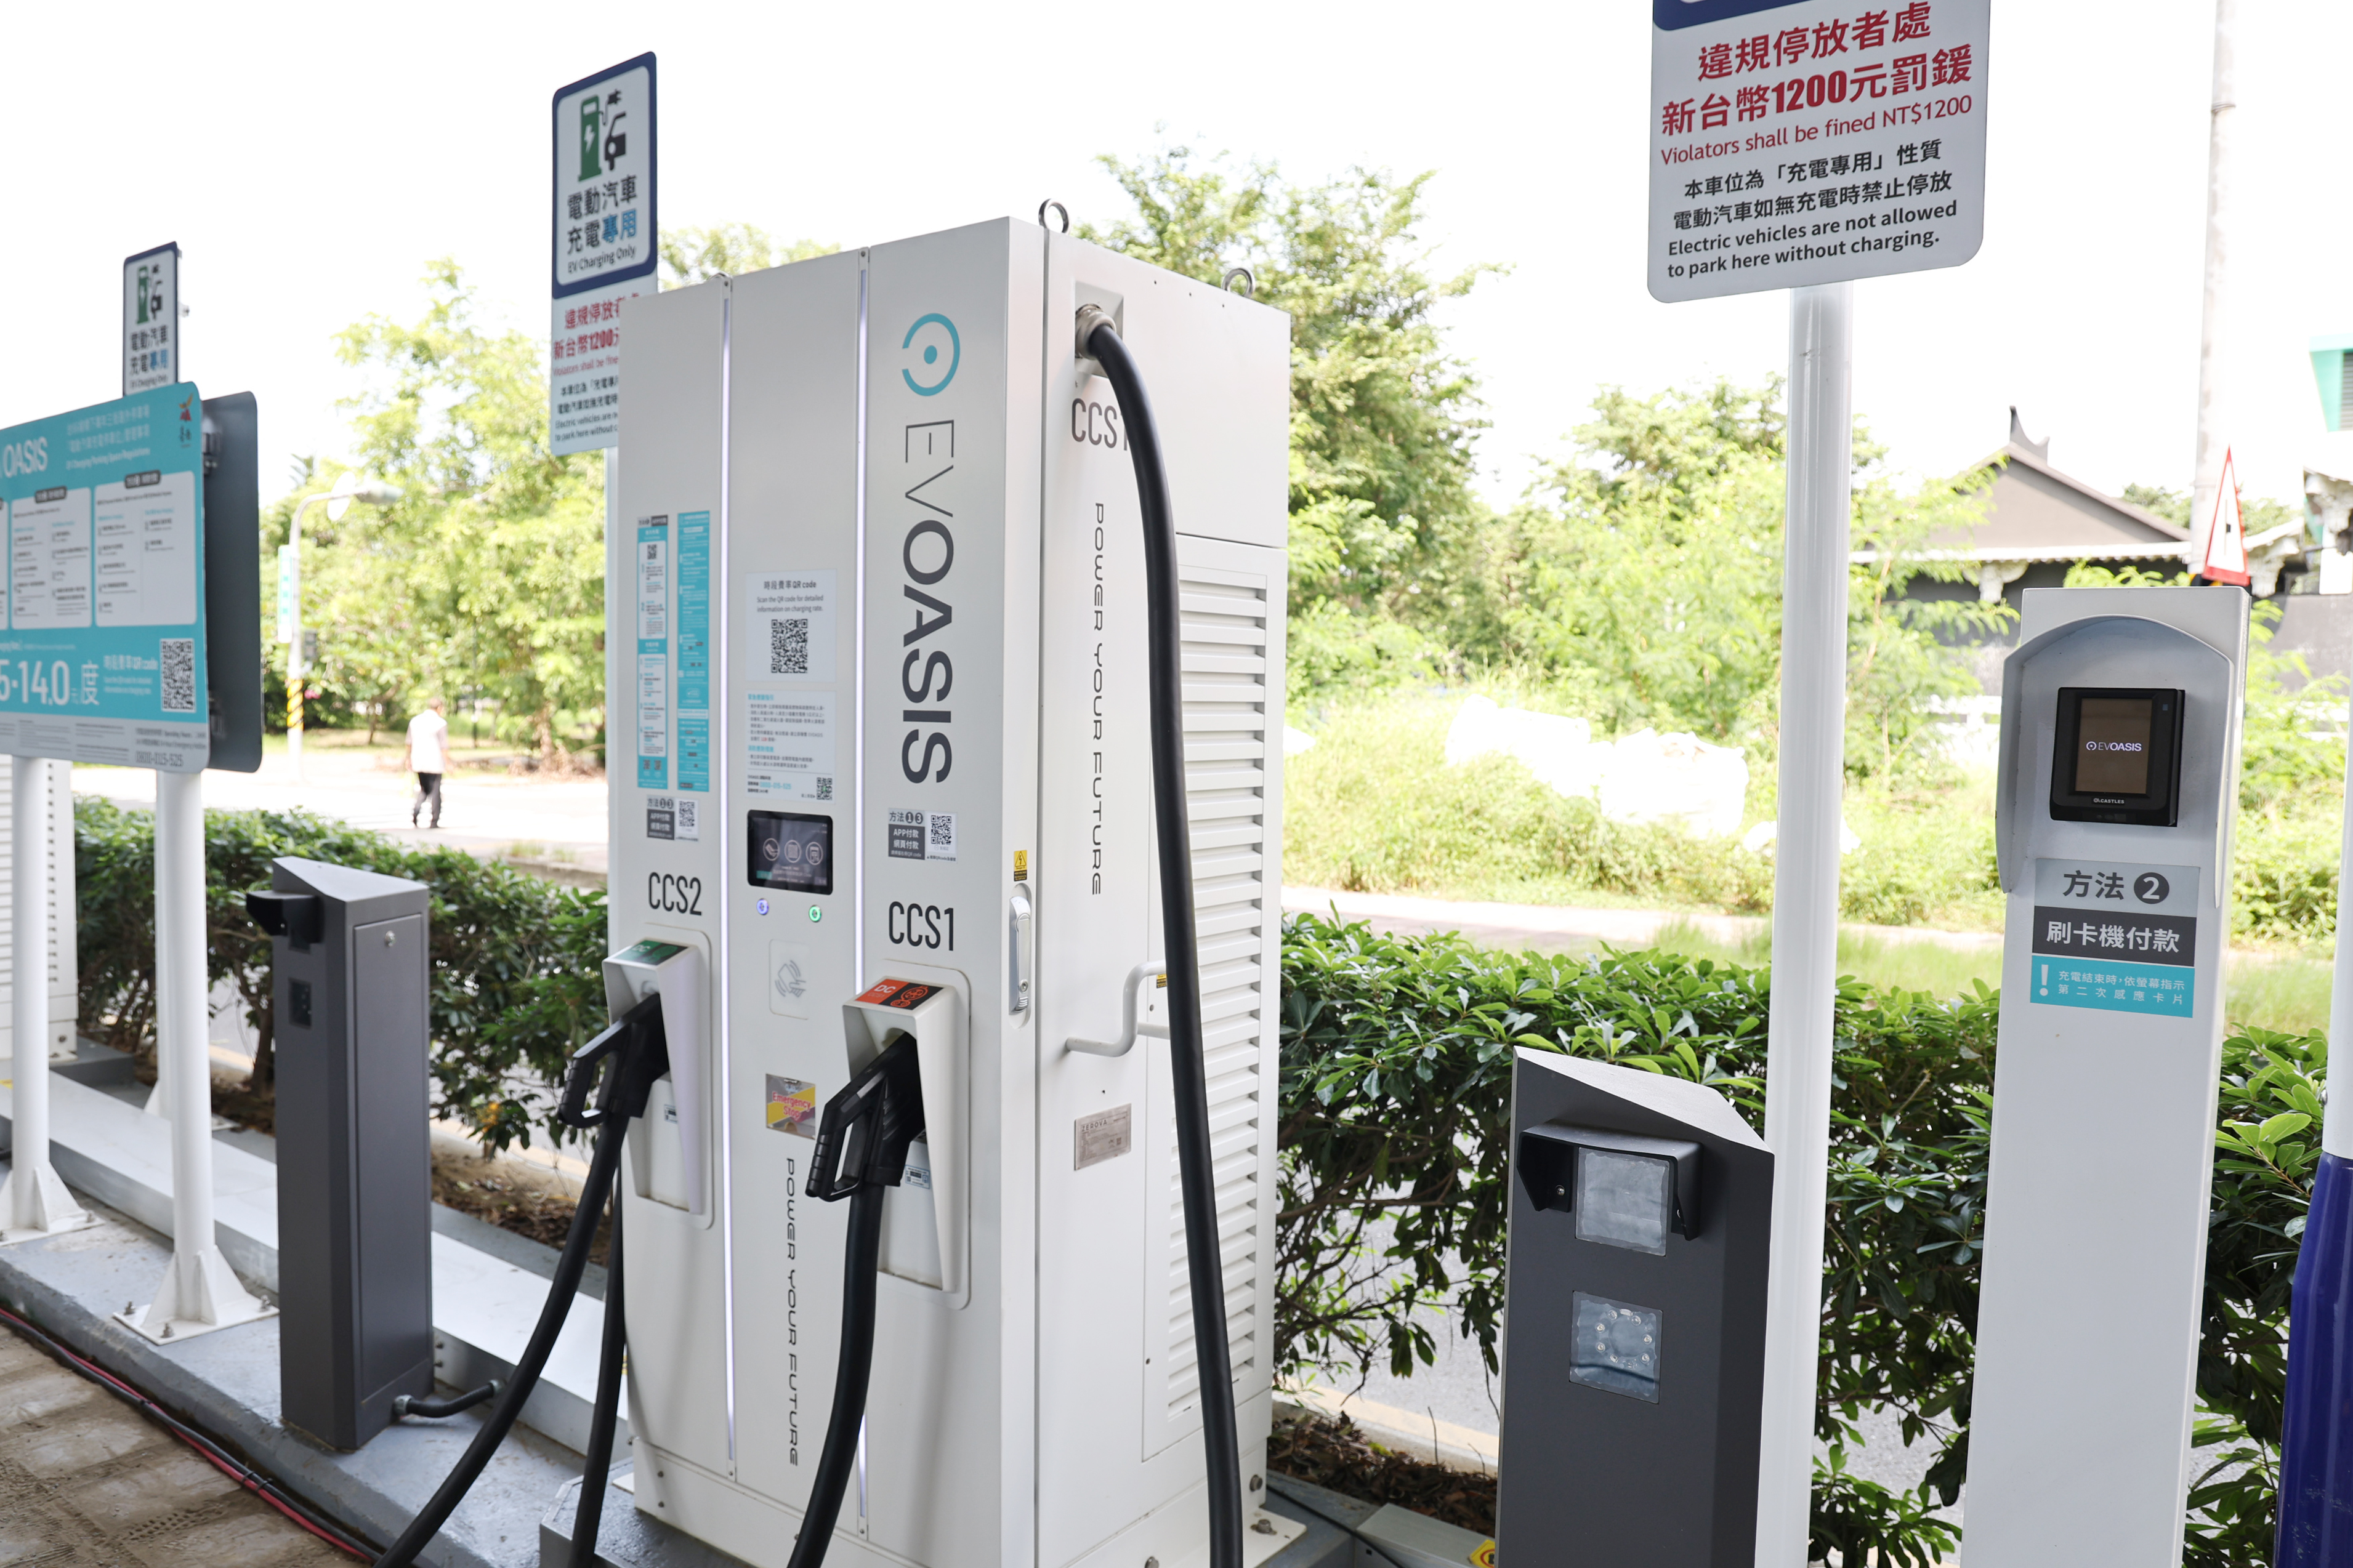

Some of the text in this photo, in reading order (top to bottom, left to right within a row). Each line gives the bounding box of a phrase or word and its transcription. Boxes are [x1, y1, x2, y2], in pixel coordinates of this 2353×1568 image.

[1698, 1, 1932, 82] 違規停放者處
[1661, 43, 1972, 137] 新台幣1200元罰鍰
[1661, 95, 1972, 165] Violators shall be fined NT$1200
[567, 174, 637, 220] 電動汽車
[1673, 170, 1953, 230] 電動汽車如無充電時禁止停放
[567, 209, 637, 255] 充電專用
[1668, 200, 1958, 255] Electric vehicles are not allowed
[568, 244, 637, 273] EV Charging Only
[1668, 229, 1940, 278] to park here without charging.
[565, 294, 639, 329] 違規停放
[606, 355, 619, 366] fine
[802, 581, 817, 589] code
[804, 594, 824, 602] detailed
[902, 419, 955, 784] EVOASIS
[1092, 502, 1104, 895] POWER YOUR FUTURE
[2098, 742, 2142, 752] EVOASIS
[893, 828, 919, 838] APP付款
[648, 872, 702, 916] CCS2
[889, 901, 954, 952] CCS1
[2046, 920, 2181, 953] 刷卡機付款
[874, 984, 897, 994] DC
[772, 1091, 812, 1112] Emergency
[783, 1106, 801, 1120] Stop
[1081, 1119, 1107, 1132] ZEROVA
[786, 1157, 799, 1467] POWER YOUR FUTURE
